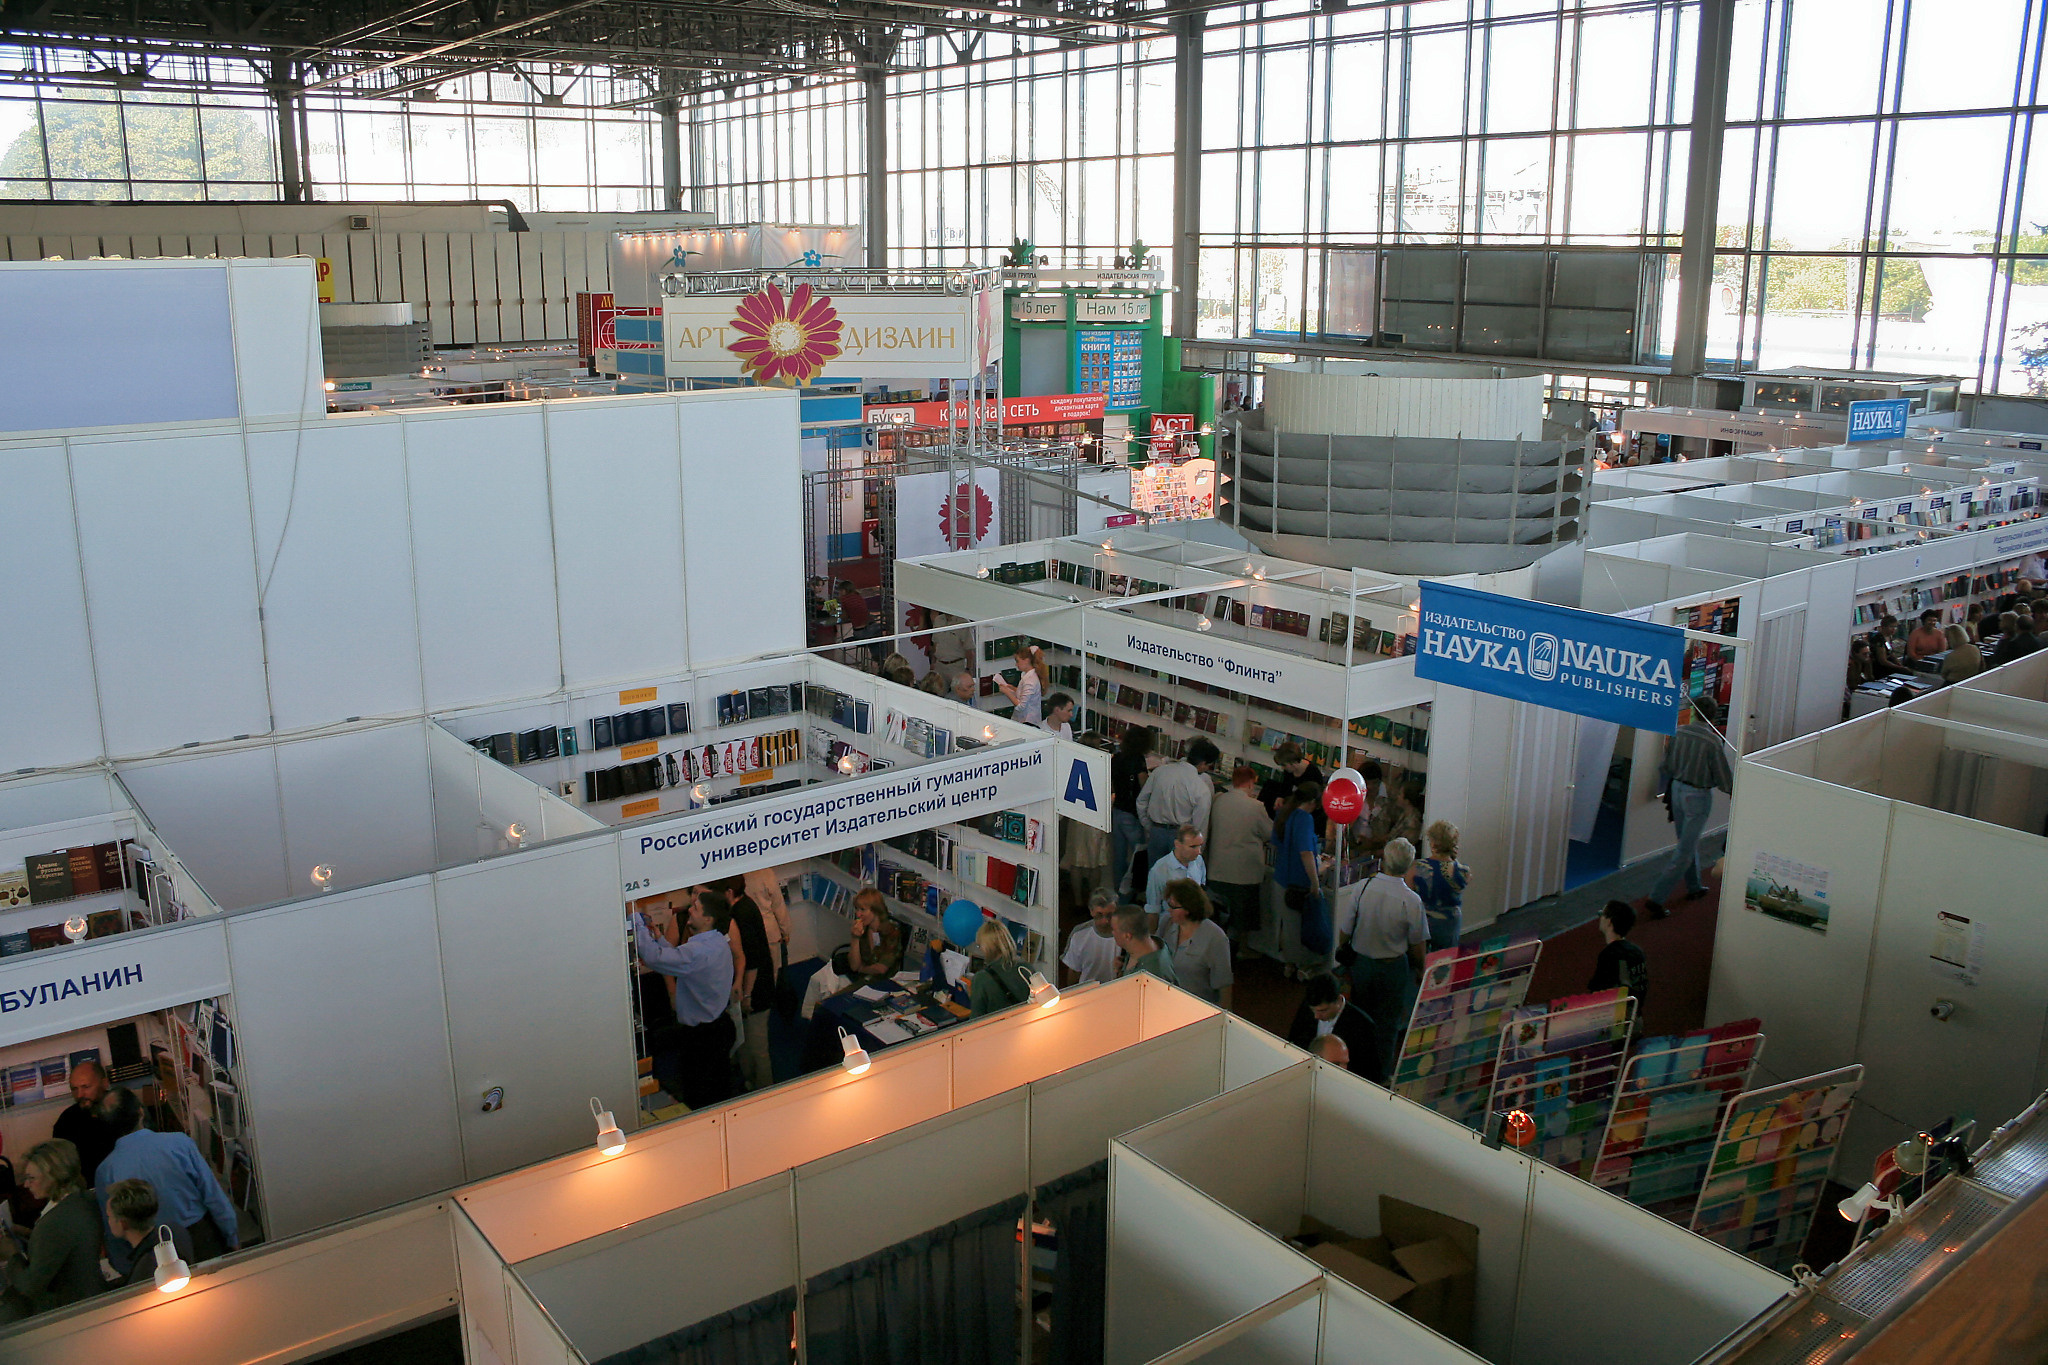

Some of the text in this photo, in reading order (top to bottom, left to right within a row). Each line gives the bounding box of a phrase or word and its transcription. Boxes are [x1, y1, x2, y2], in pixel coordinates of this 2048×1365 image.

[317, 262, 330, 281] Р
[1035, 303, 1057, 315] лет
[1087, 303, 1116, 315] Нам
[1122, 302, 1134, 315] 15
[679, 327, 729, 349] АРТ
[1081, 343, 1111, 351] КНИГИ
[1010, 404, 1040, 418] СЕТЬ
[1050, 397, 1073, 406] каждому
[1153, 417, 1190, 432] АСТ
[1852, 410, 1893, 431] НАУКА
[1425, 611, 1526, 642] ИЗДАТЕЛЬСТВО
[1127, 634, 1214, 668] Издательство
[1423, 629, 1525, 675] НАУКА
[1561, 638, 1676, 689] NAUKA
[1561, 672, 1673, 707] PUBLISHERS
[1063, 758, 1098, 813] А
[640, 750, 1043, 854] Российский государственный гуманитарный
[700, 782, 998, 869] университет Издательский центр
[643, 878, 650, 888] 3
[1, 963, 144, 1014] БУЛАНИН
